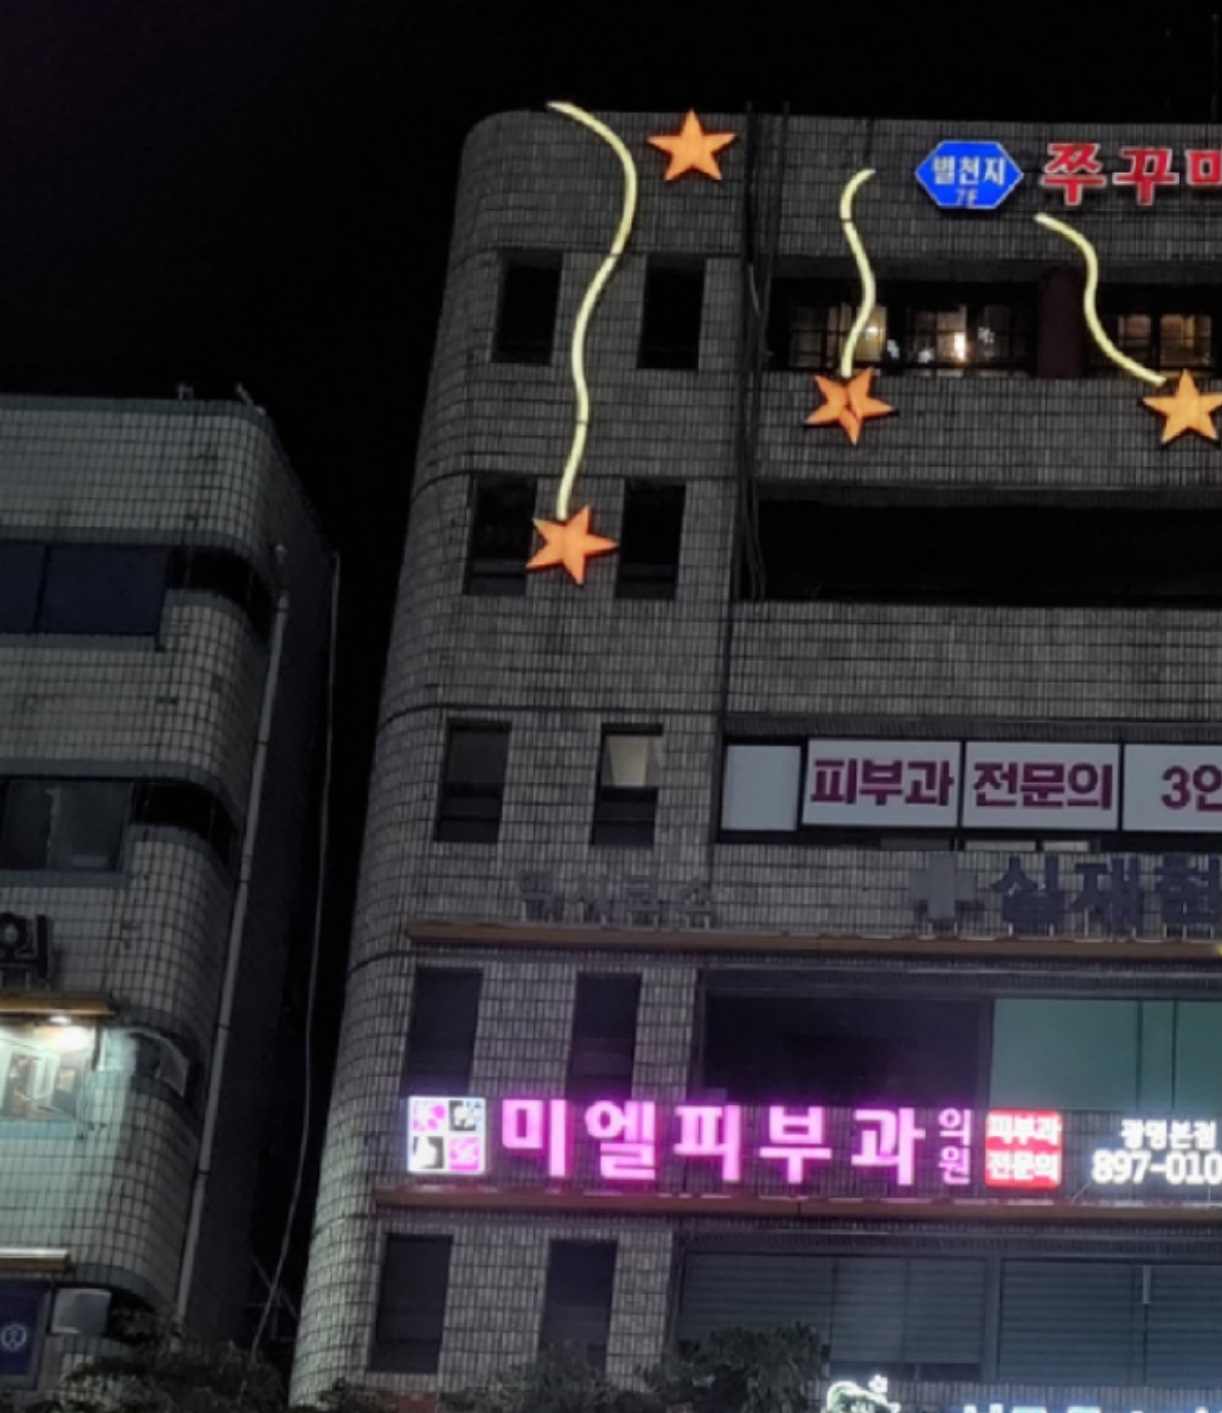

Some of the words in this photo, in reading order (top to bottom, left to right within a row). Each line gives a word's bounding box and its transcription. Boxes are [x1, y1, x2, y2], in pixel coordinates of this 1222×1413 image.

[810, 758, 954, 807] 피부과
[972, 762, 1114, 811] 전문의
[501, 1098, 926, 1187] 미엘피부과
